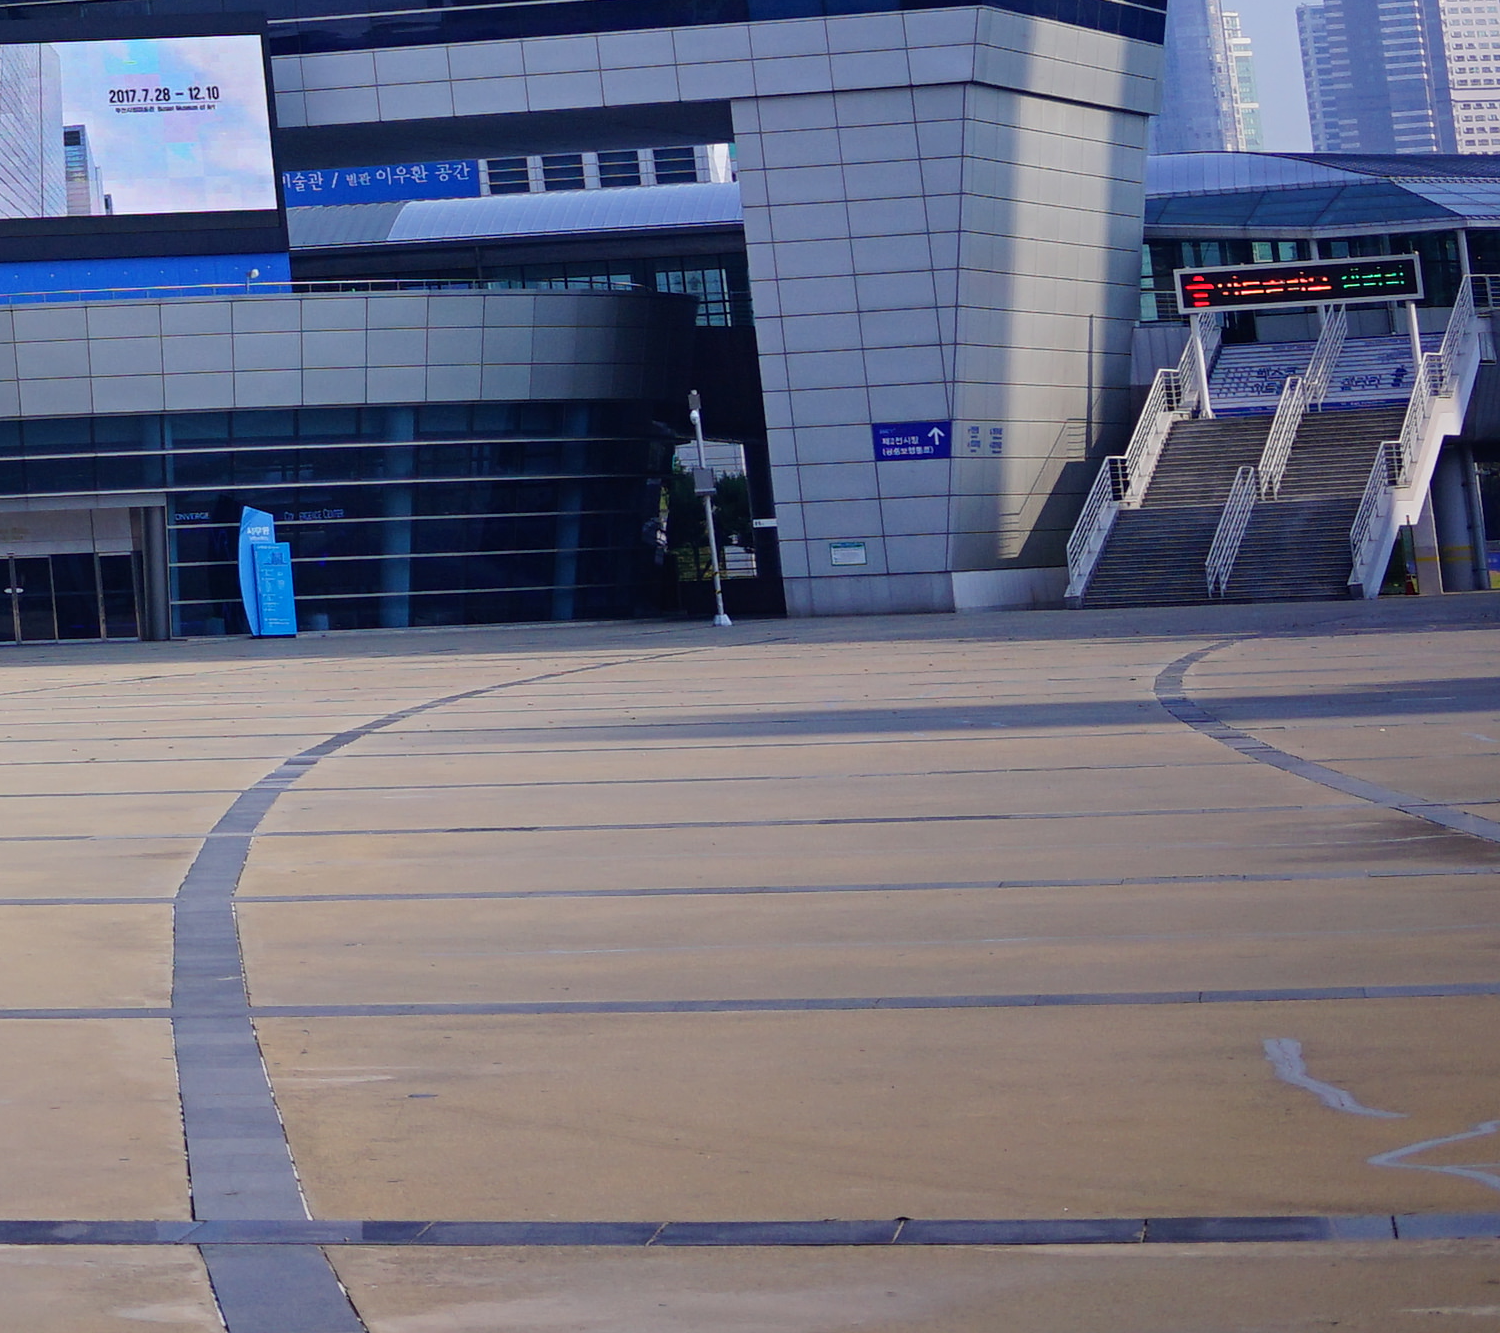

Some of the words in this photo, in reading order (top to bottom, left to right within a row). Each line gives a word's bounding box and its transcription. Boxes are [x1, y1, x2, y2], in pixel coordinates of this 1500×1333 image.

[108, 87, 172, 104] 2017.7.28
[188, 85, 221, 101] 12.10
[375, 164, 429, 187] 이우환
[434, 161, 472, 182] 공간
